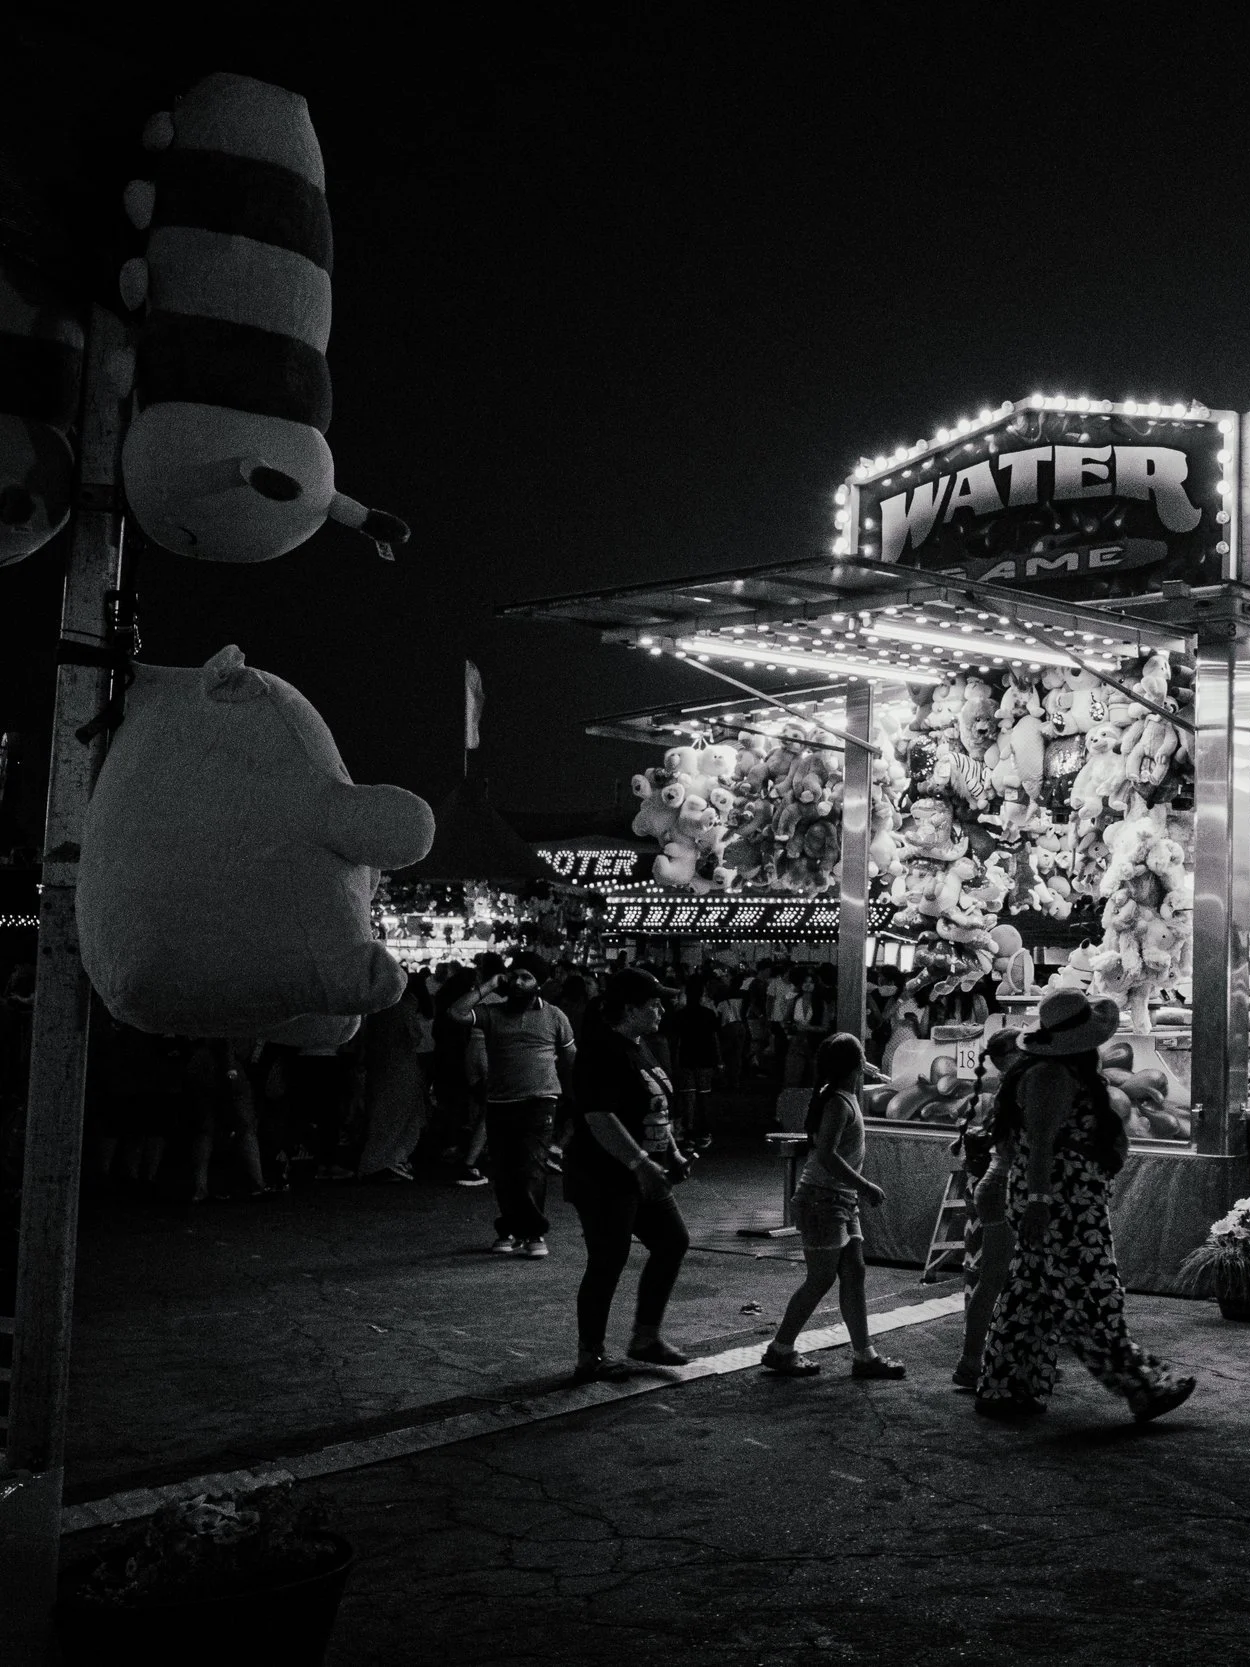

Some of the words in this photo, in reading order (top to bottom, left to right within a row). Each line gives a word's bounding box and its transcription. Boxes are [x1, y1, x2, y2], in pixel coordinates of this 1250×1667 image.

[880, 444, 1202, 562] WATER
[537, 850, 638, 876] OTER
[960, 1050, 976, 1069] 18
